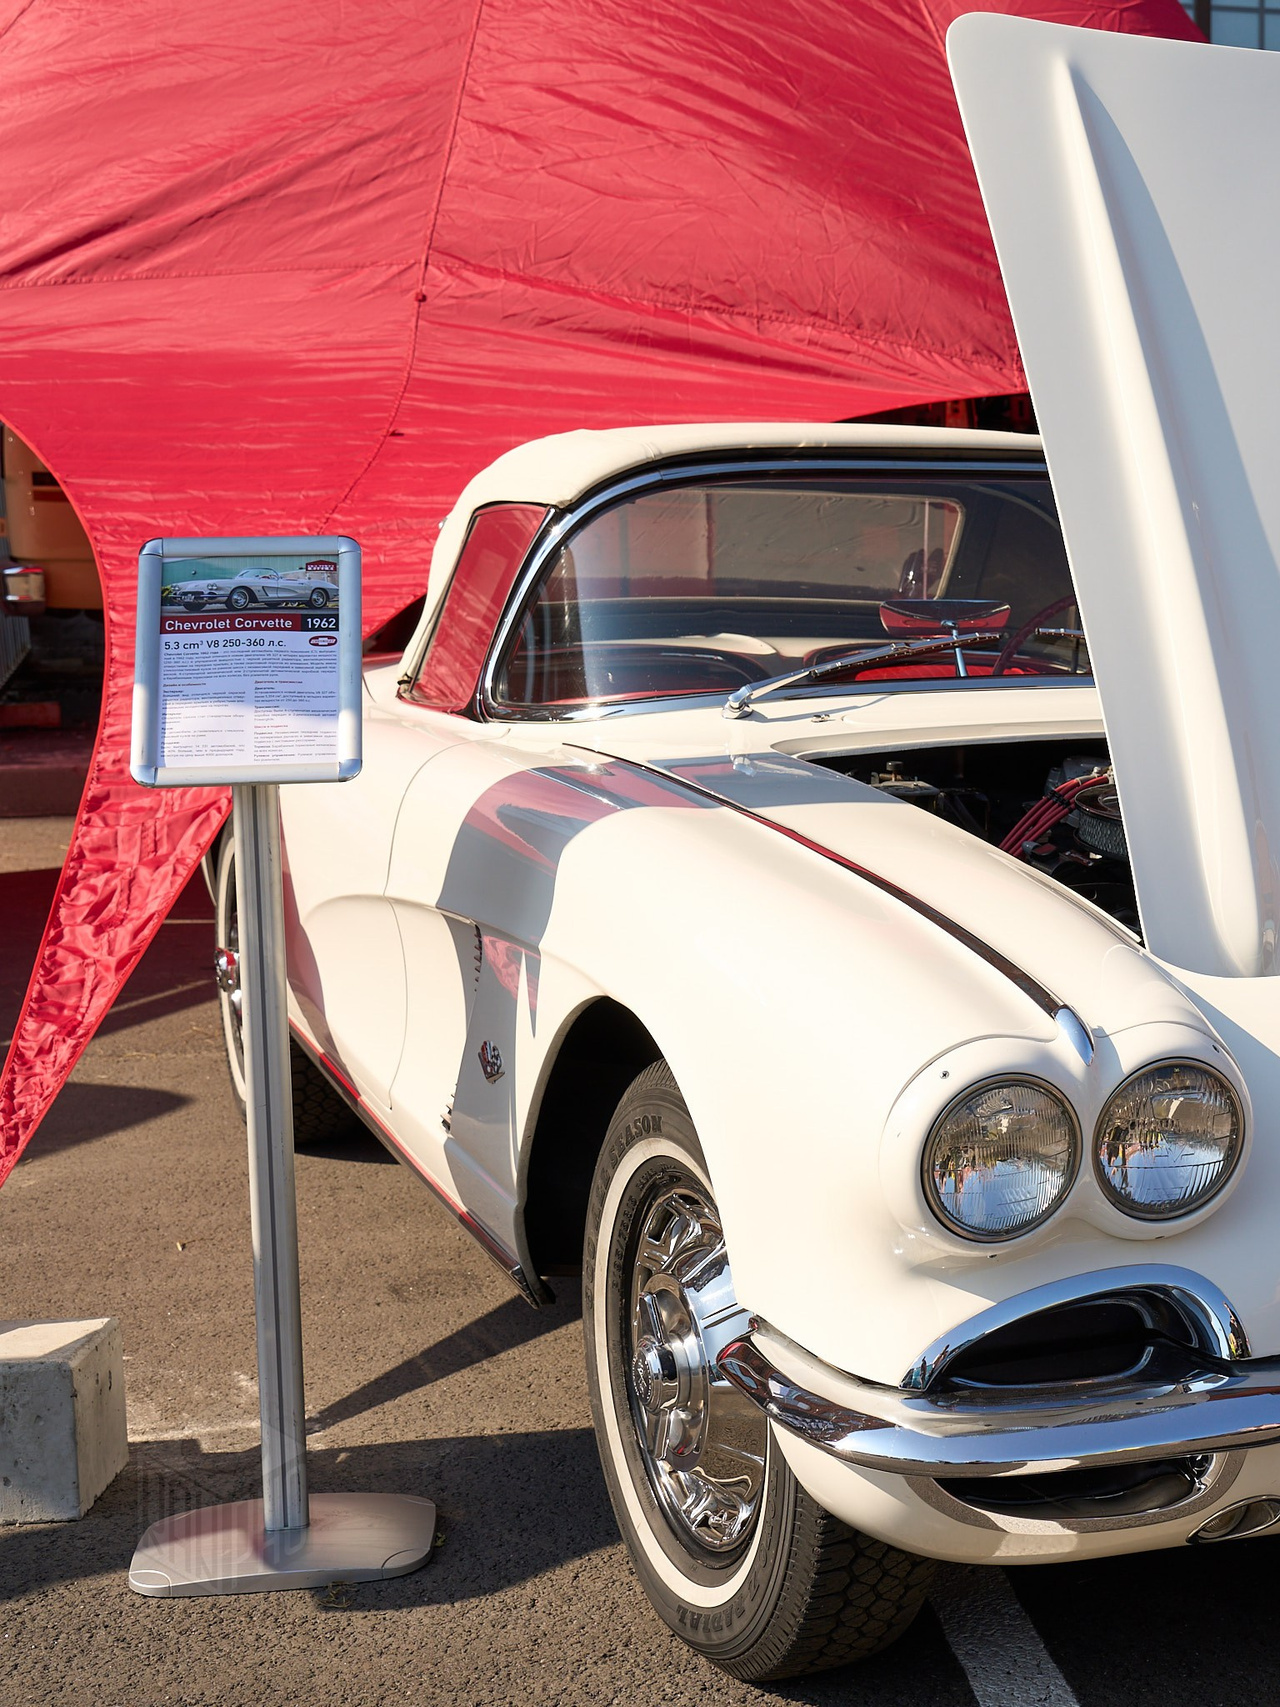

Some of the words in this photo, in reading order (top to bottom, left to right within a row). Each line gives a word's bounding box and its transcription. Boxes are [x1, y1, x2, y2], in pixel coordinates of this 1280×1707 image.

[165, 618, 230, 631] Chevrolet
[235, 617, 292, 629] Corvette
[307, 618, 336, 629] 1962
[164, 641, 180, 650] 5.3
[206, 639, 220, 648] V8
[222, 638, 265, 648] 250-360
[608, 1114, 663, 1170] SEASON
[675, 1595, 747, 1635] RADIAL
